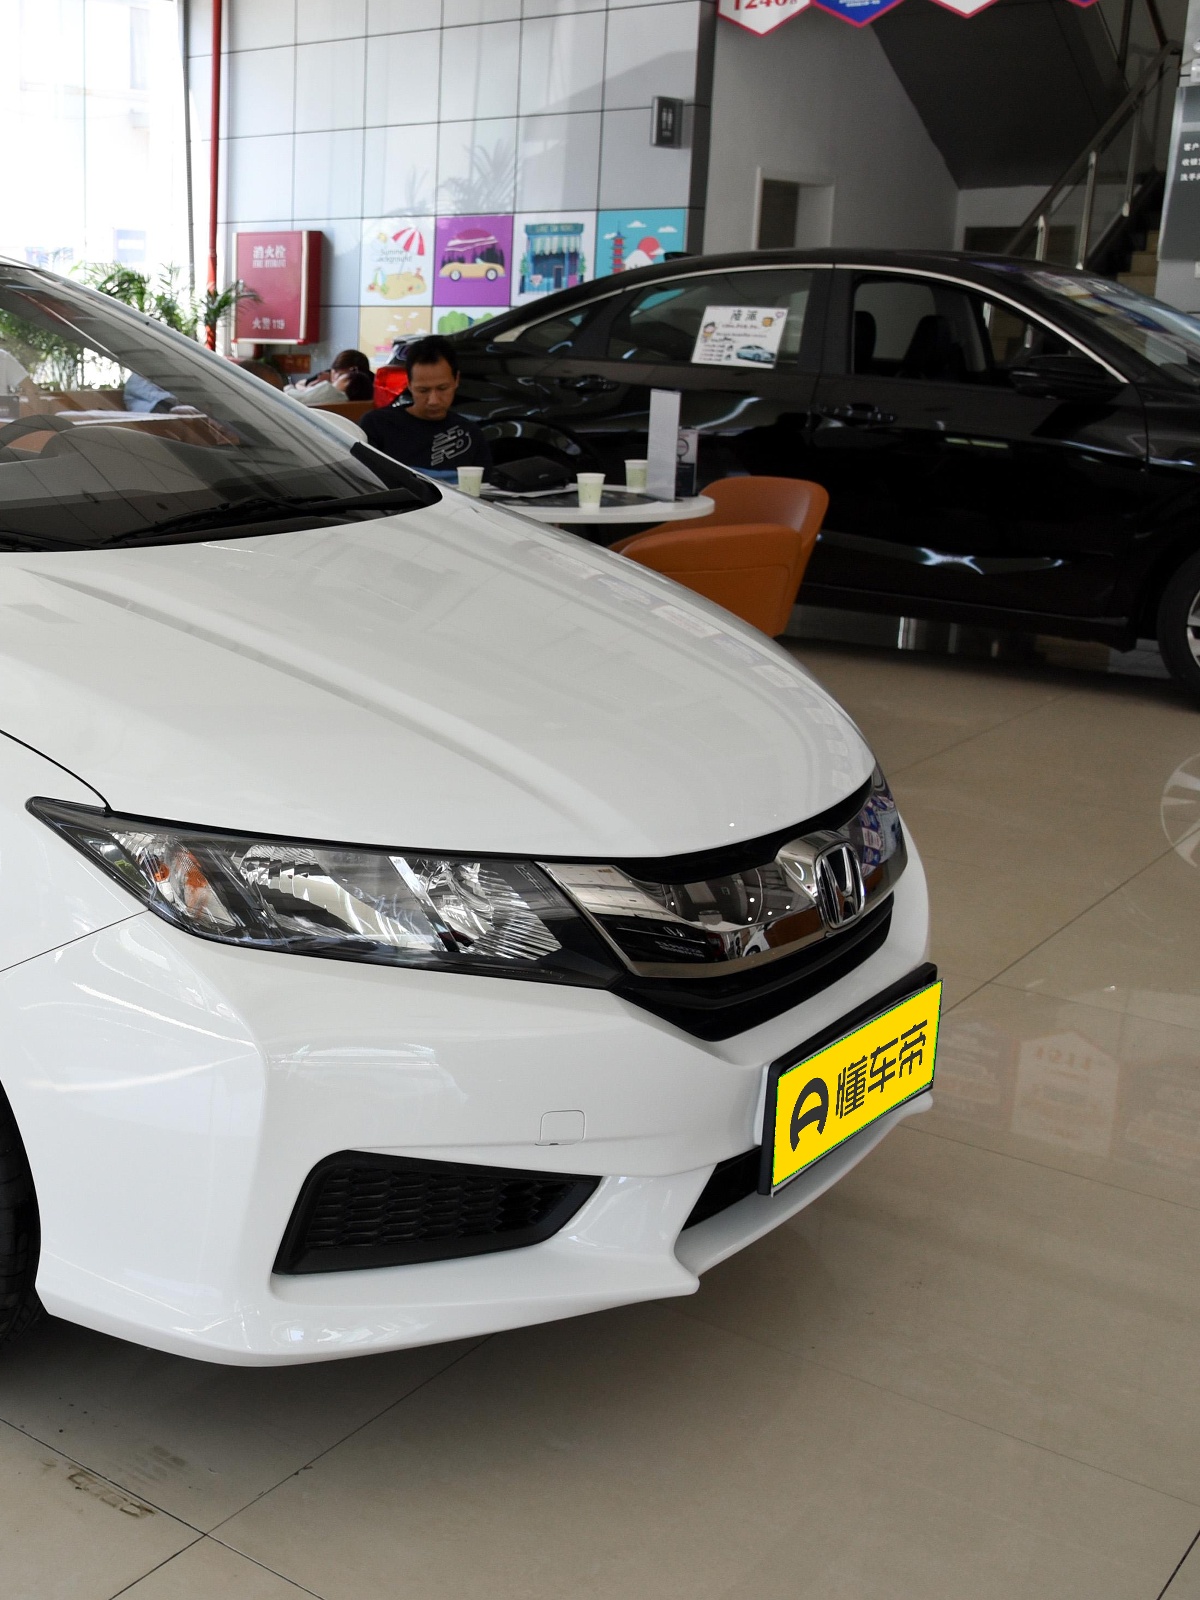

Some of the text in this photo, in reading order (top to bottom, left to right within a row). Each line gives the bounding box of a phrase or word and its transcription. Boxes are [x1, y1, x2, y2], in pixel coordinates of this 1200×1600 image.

[1181, 157, 1200, 167] 收银
[253, 244, 286, 259] 消火栓
